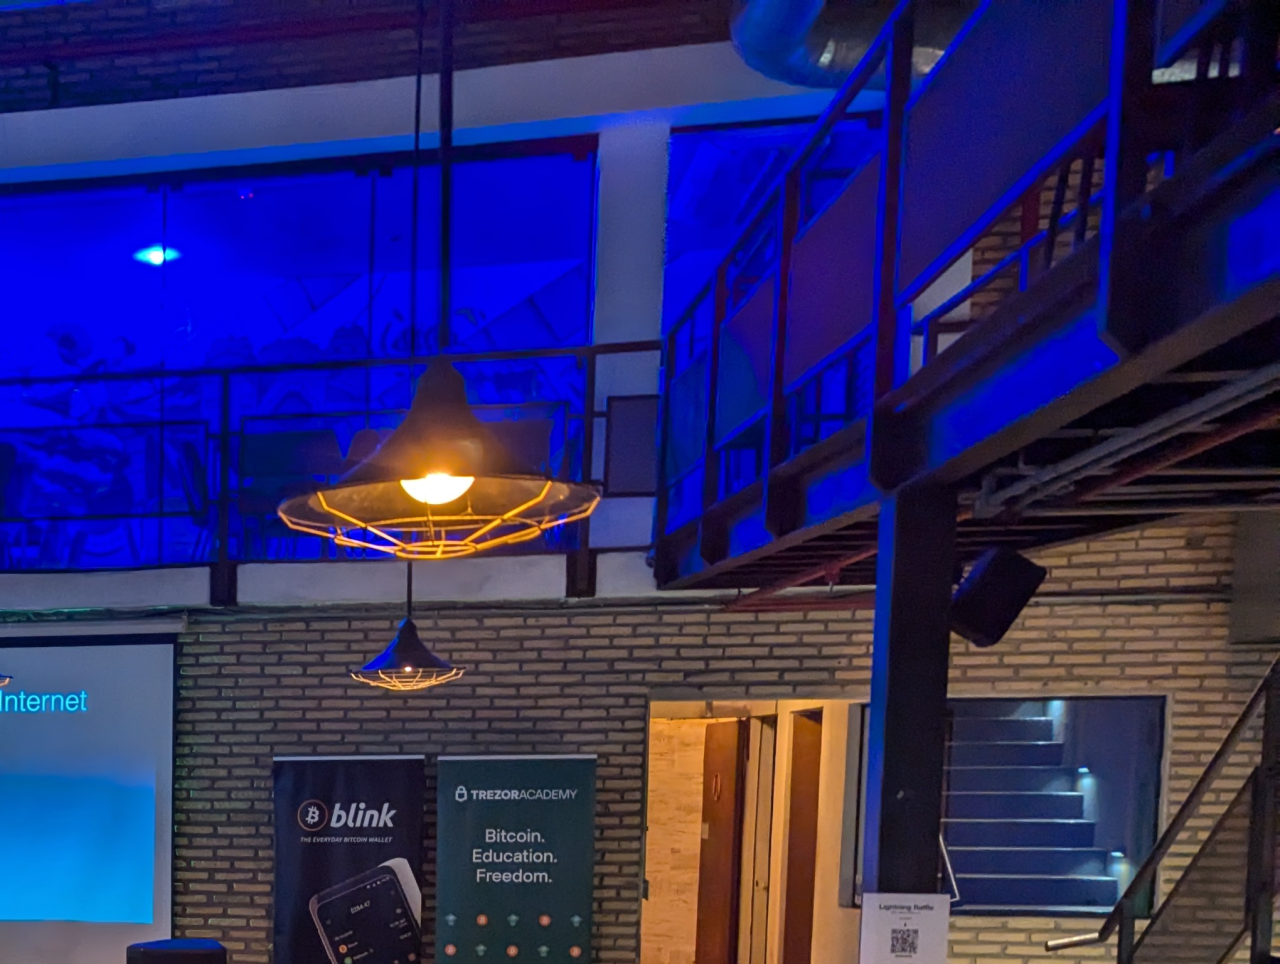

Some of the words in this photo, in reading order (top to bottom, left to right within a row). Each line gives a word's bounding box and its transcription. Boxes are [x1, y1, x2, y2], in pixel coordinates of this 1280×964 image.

[329, 802, 397, 828] blink
[485, 828, 545, 843] Bitcoin.
[472, 848, 558, 863] Education.
[476, 868, 553, 883] Freedom.
[879, 903, 912, 911] Lightning
